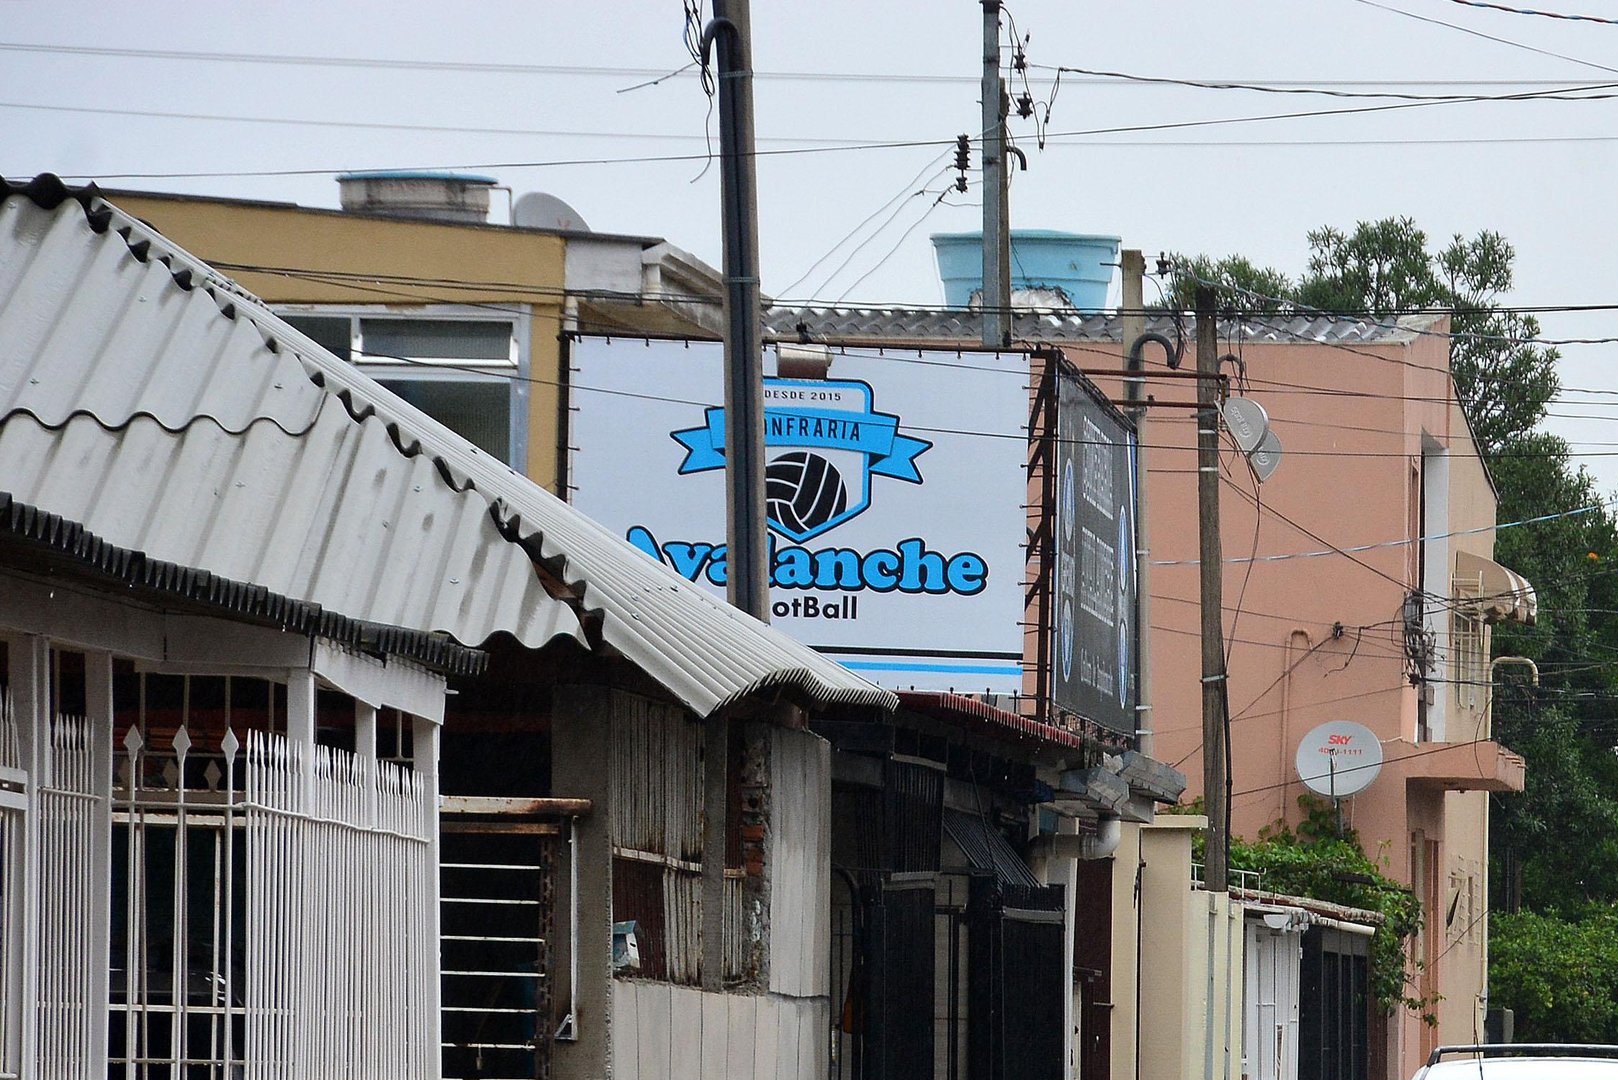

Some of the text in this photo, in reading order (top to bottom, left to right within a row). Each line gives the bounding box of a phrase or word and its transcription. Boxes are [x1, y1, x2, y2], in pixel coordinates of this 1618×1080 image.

[764, 389, 842, 402] DESDE 2015
[764, 416, 861, 441] NFRARIA
[1328, 734, 1352, 745] SKY
